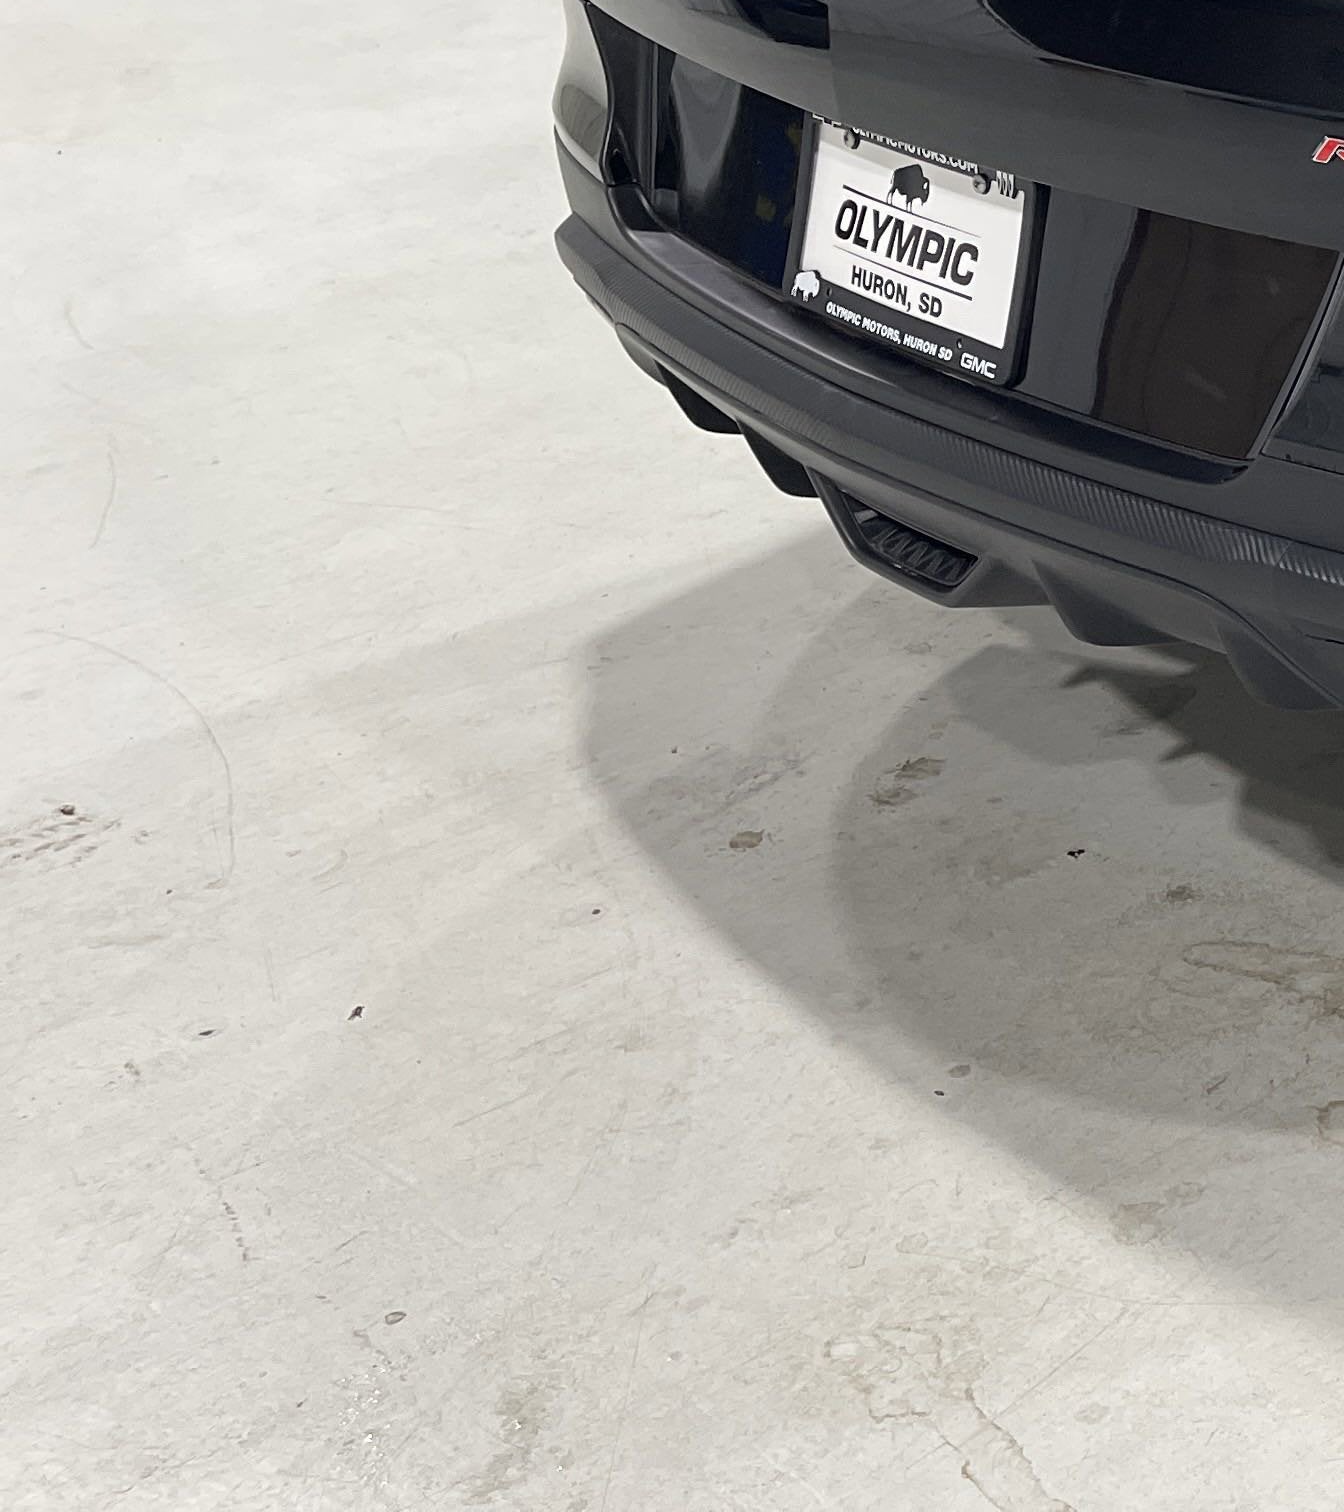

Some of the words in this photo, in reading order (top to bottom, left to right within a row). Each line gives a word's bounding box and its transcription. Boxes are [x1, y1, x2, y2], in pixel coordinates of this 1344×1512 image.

[834, 199, 979, 286] OLYMPIC
[851, 265, 912, 312] HURON,
[918, 292, 942, 318] SD
[826, 301, 862, 327] OLYMPIC
[862, 317, 901, 345] MOTORS,
[903, 333, 937, 356] HURON
[937, 346, 953, 361] SD
[960, 352, 997, 379] GMC
